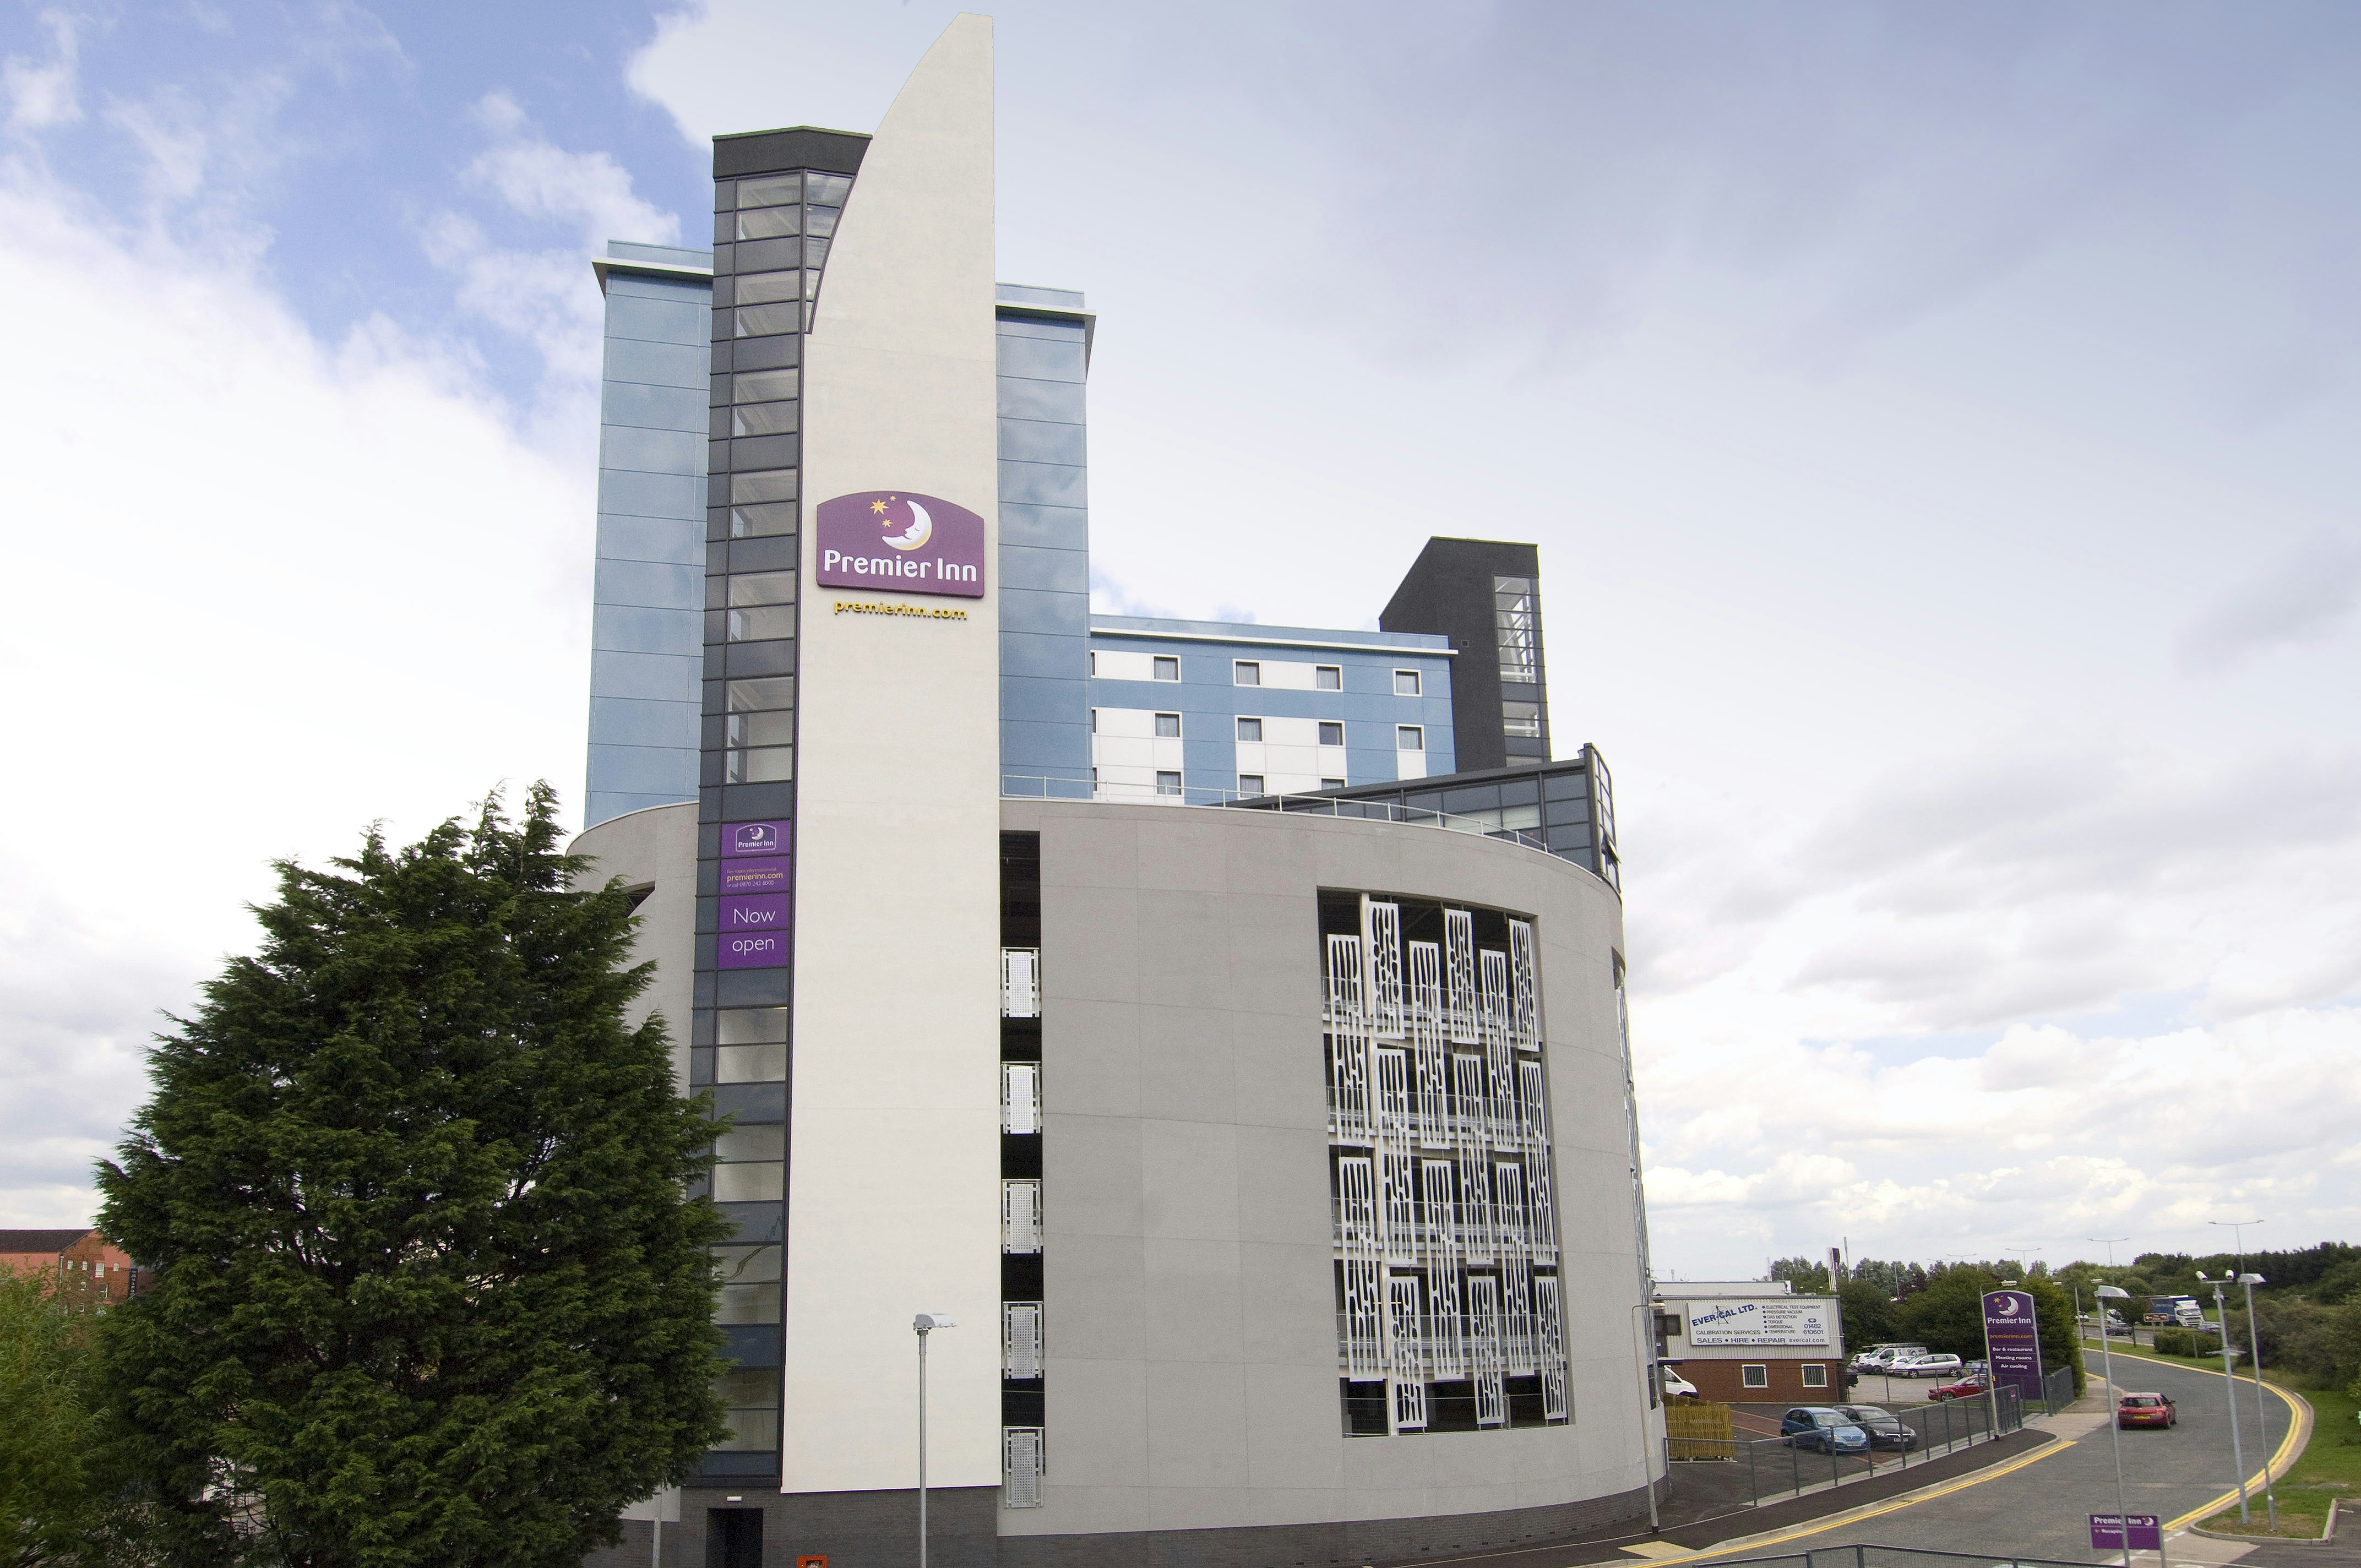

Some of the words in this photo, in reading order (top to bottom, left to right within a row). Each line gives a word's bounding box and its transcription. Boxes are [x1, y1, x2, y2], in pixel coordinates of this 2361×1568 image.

[824, 549, 932, 579] Premier
[937, 558, 977, 582] Inn
[834, 601, 967, 620] premierinn.com
[727, 873, 783, 884] premierinn.com
[734, 908, 776, 924] Now
[732, 938, 774, 956] open
[1738, 1304, 1758, 1314] LTD.
